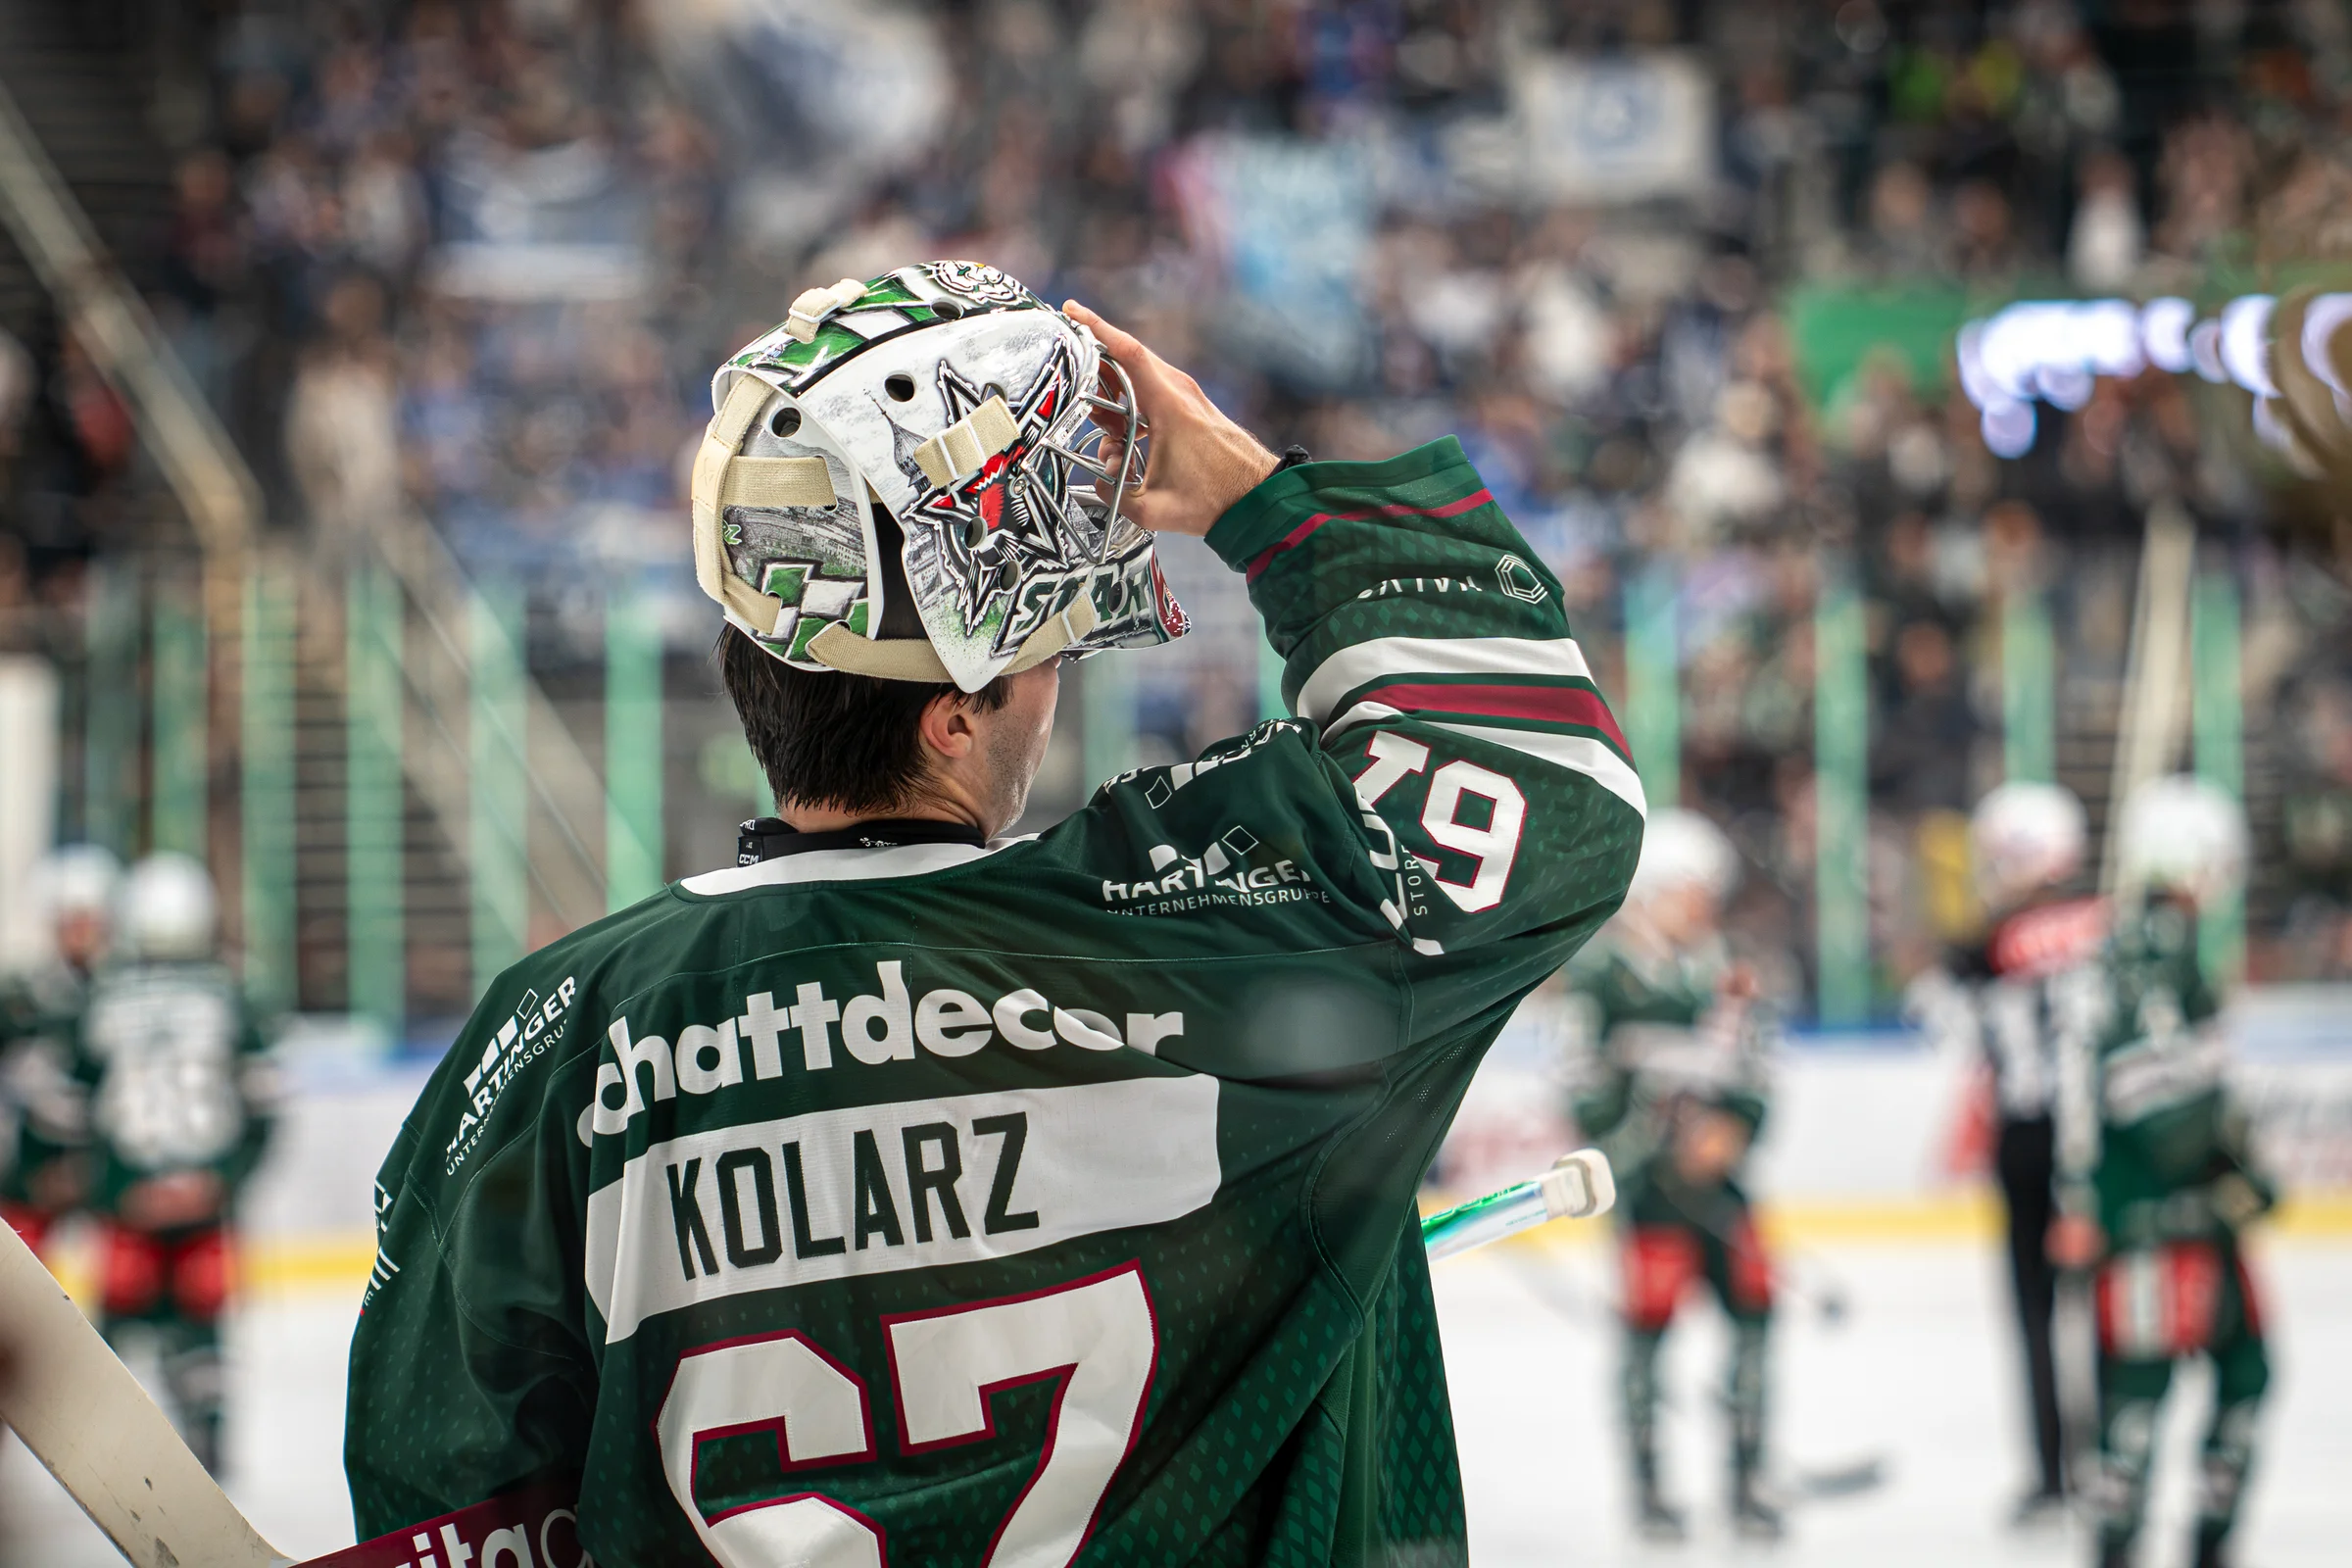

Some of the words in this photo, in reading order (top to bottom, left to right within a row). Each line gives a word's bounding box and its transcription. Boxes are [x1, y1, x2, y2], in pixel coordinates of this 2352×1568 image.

[739, 854, 760, 864] CCM
[665, 1110, 1040, 1281] KOLARZ
[655, 1257, 1160, 1568] 67
